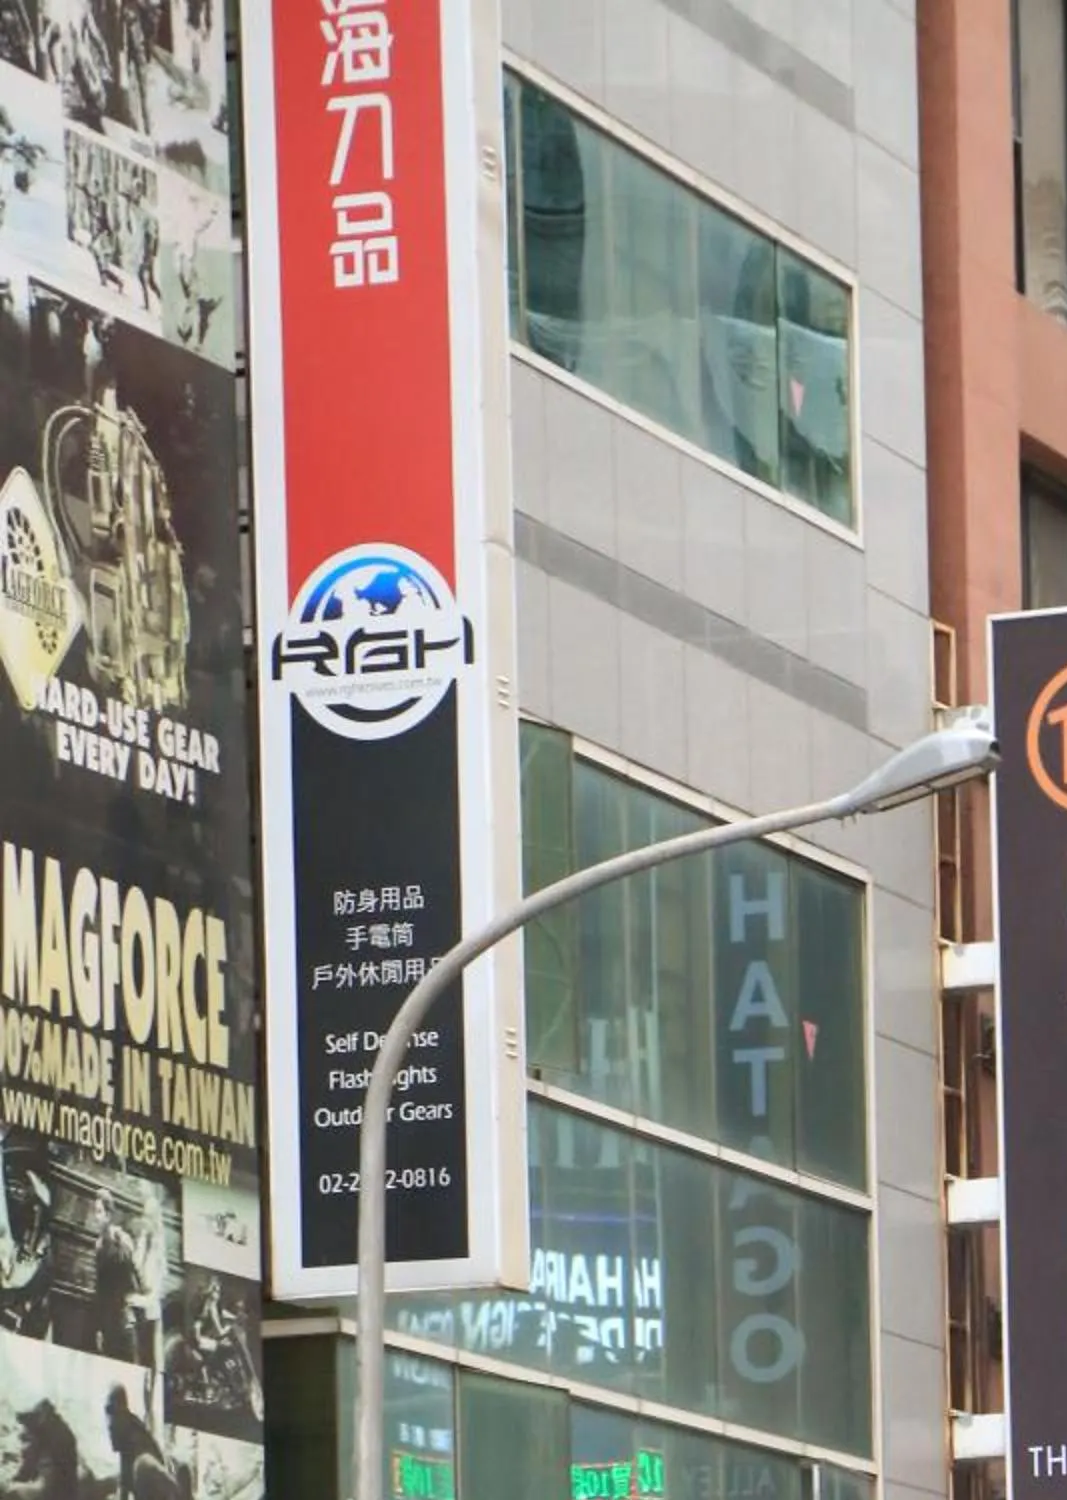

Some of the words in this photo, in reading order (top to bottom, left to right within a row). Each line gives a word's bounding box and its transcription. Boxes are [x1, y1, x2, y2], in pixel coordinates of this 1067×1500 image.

[271, 616, 475, 681] RGH
[157, 717, 221, 774] GEAR
[56, 721, 131, 781] EVERY
[138, 752, 197, 806] DAY!
[333, 885, 425, 914] 防身用品
[345, 922, 414, 951] 手電筒
[1, 842, 230, 1069] MAGFORCE
[312, 957, 443, 990] 戶外休閒用
[325, 1032, 359, 1054] Self
[363, 1031, 439, 1051] Dense
[328, 1066, 437, 1091] Flashghts
[122, 1045, 151, 1118] IN
[158, 1057, 256, 1149] TAIWAN
[314, 1106, 395, 1128] Outdr
[399, 1101, 453, 1121] Gears
[2, 1086, 232, 1187] www.magforce.com.tw
[318, 1168, 451, 1194] 02-22-0816
